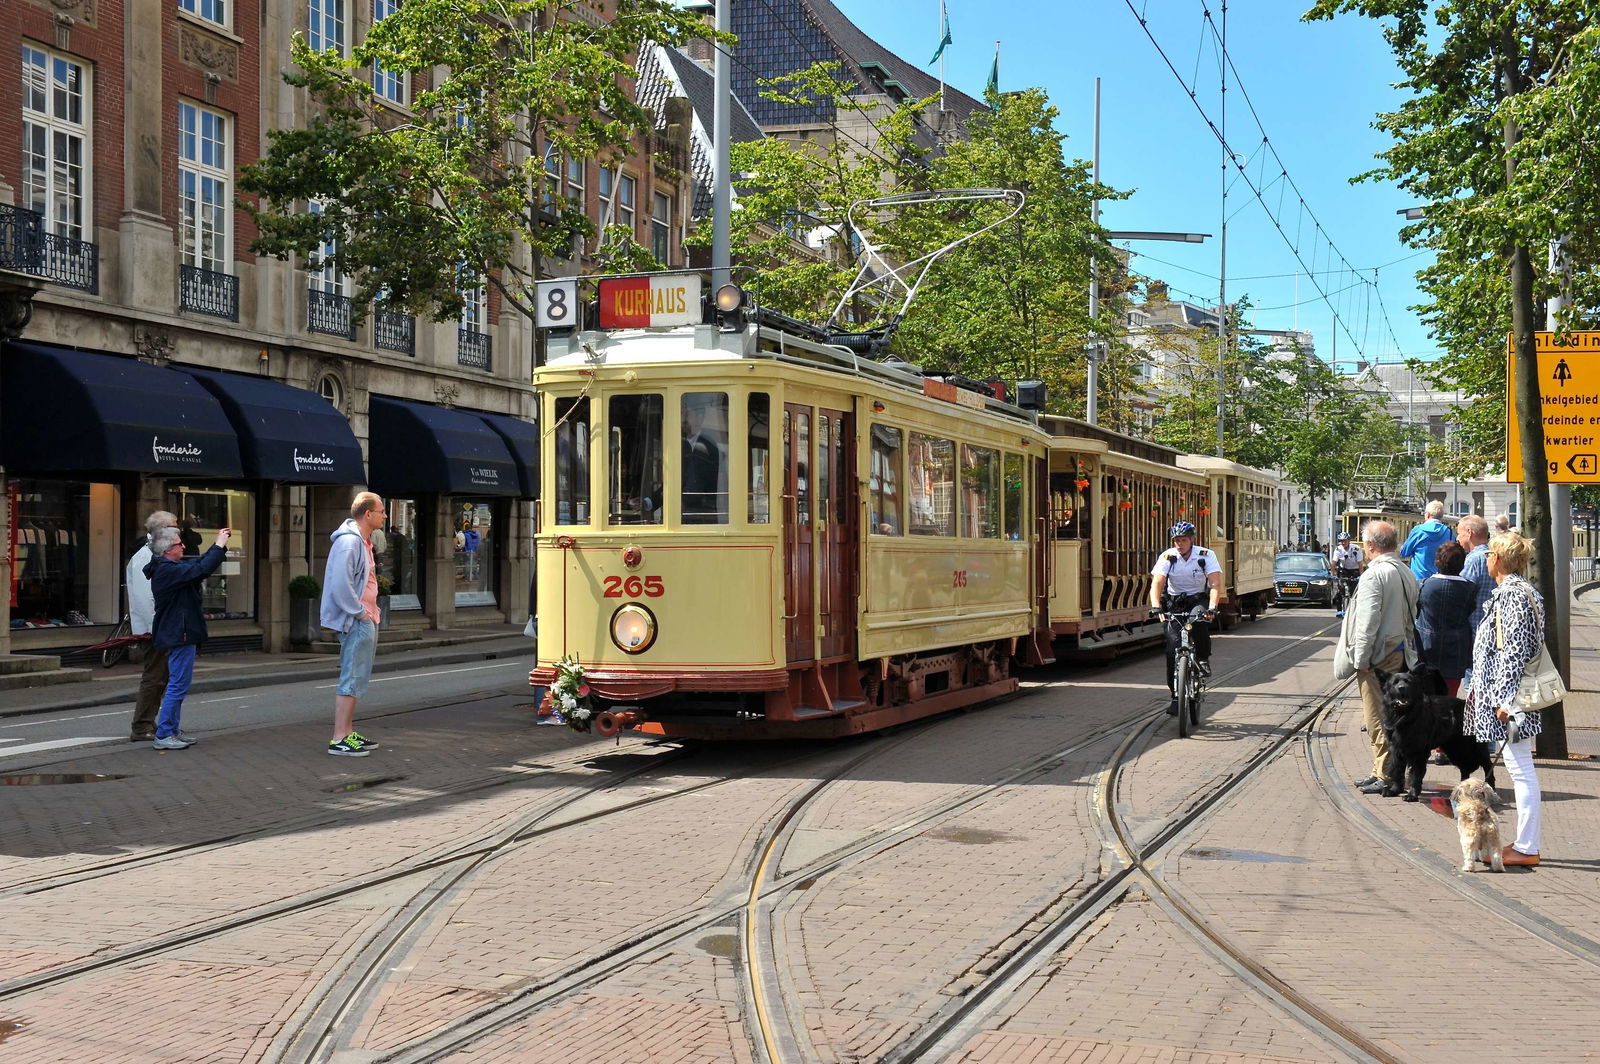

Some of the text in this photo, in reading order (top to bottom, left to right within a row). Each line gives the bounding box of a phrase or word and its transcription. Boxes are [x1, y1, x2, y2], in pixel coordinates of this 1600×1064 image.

[547, 288, 567, 321] 8
[614, 287, 686, 317] KURHAUS
[1540, 394, 1598, 407] nkelgebied
[1543, 415, 1584, 425] rdeinde
[152, 435, 202, 464] fonderie
[1545, 435, 1594, 446] kwartier
[293, 447, 334, 473] fonderie
[603, 574, 665, 599] 265
[953, 570, 967, 588] 265
